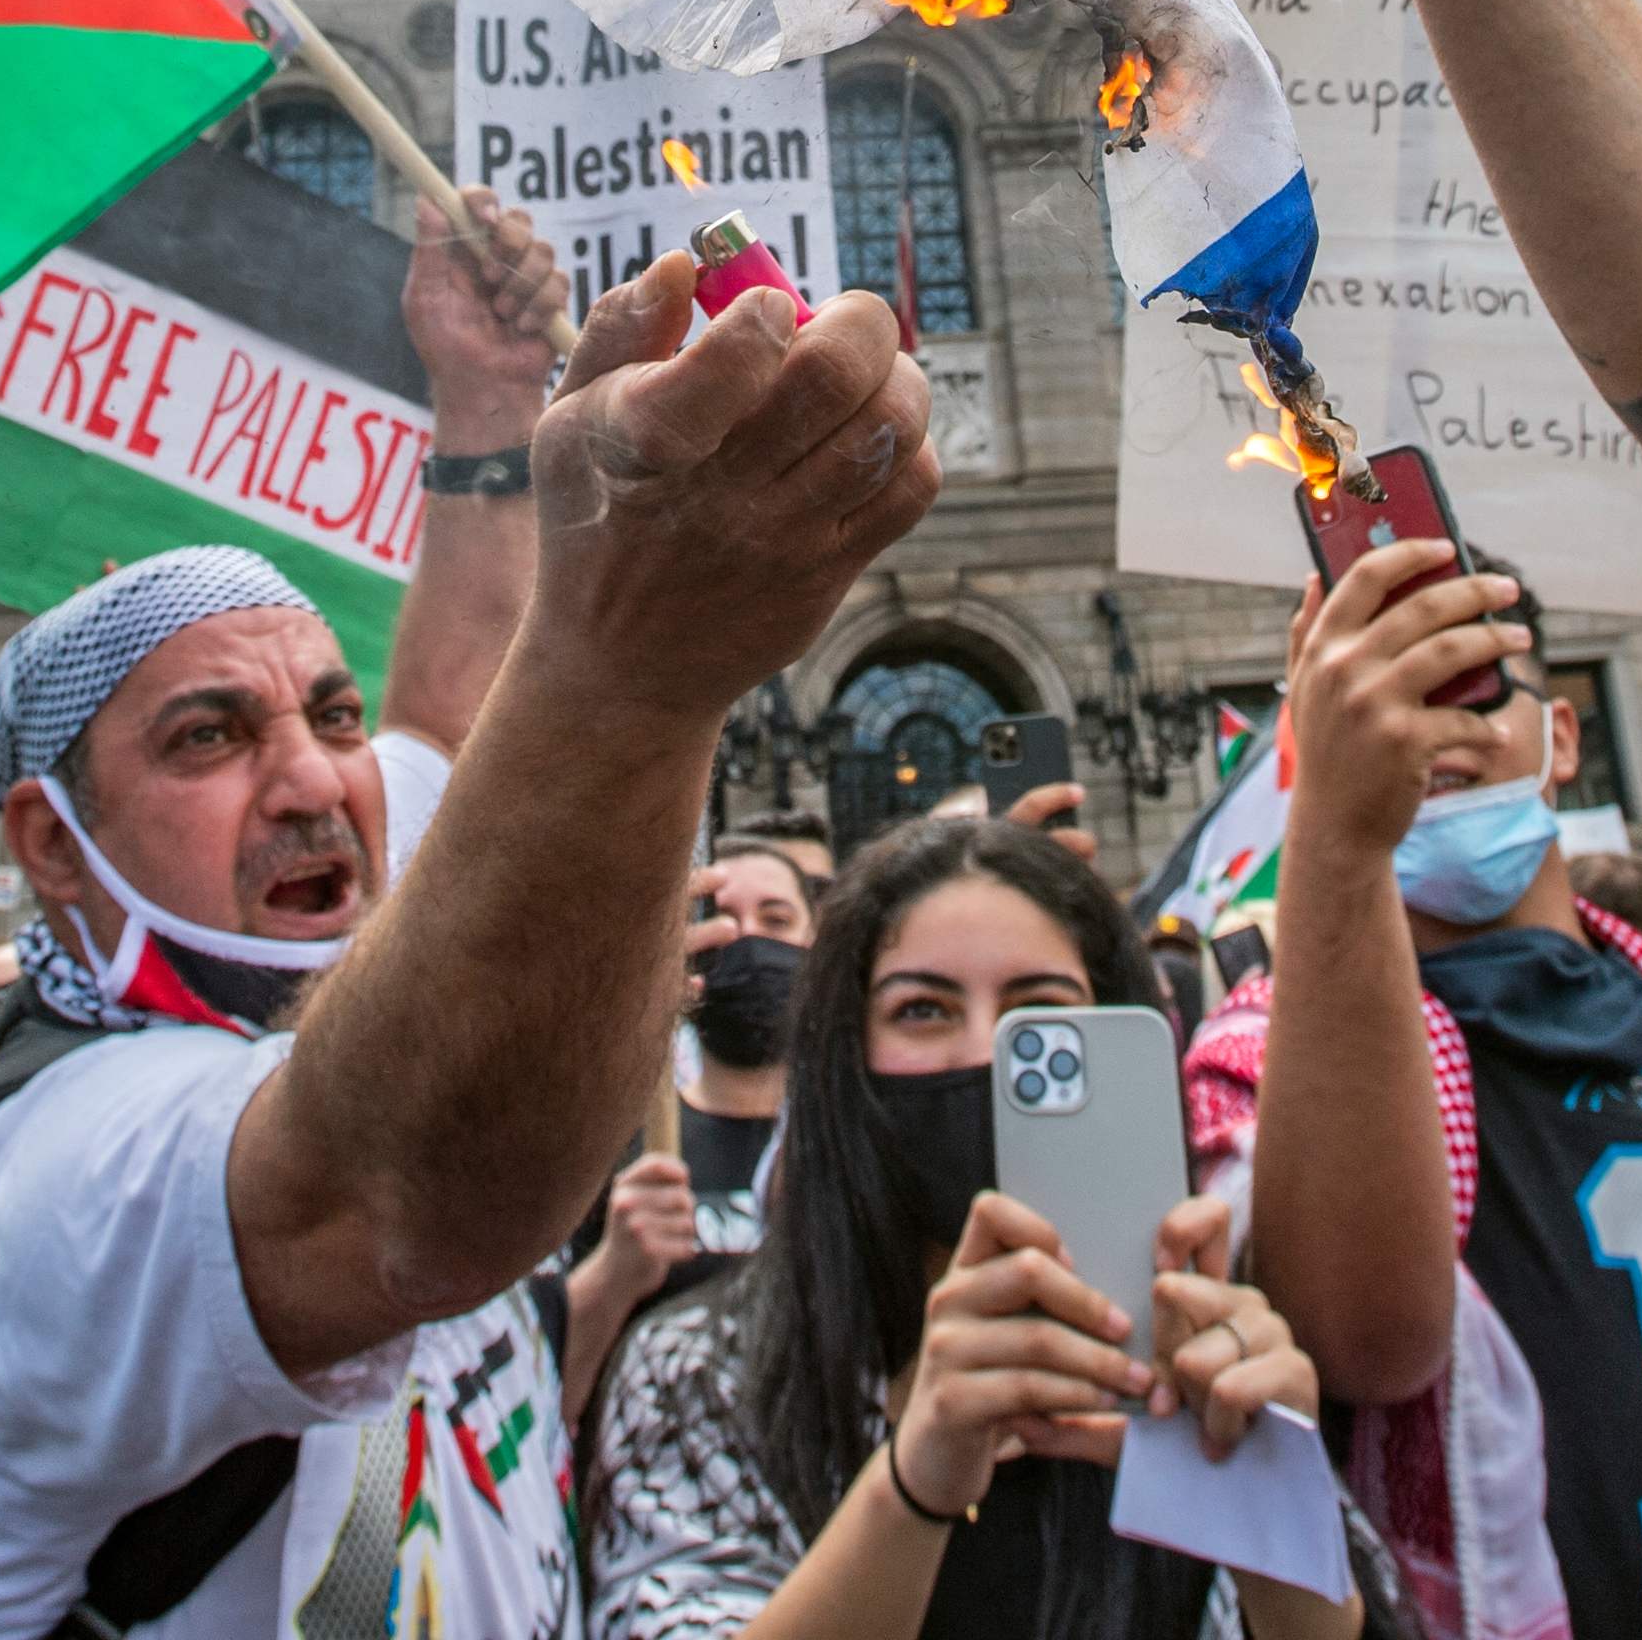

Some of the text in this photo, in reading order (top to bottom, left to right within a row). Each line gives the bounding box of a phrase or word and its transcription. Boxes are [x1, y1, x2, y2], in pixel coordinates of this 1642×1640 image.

[477, 17, 564, 86] U.S.
[479, 106, 810, 200] Palestinian
[1422, 177, 1503, 236] the
[1303, 260, 1530, 317] nexation
[1405, 370, 1641, 466] Palestin
